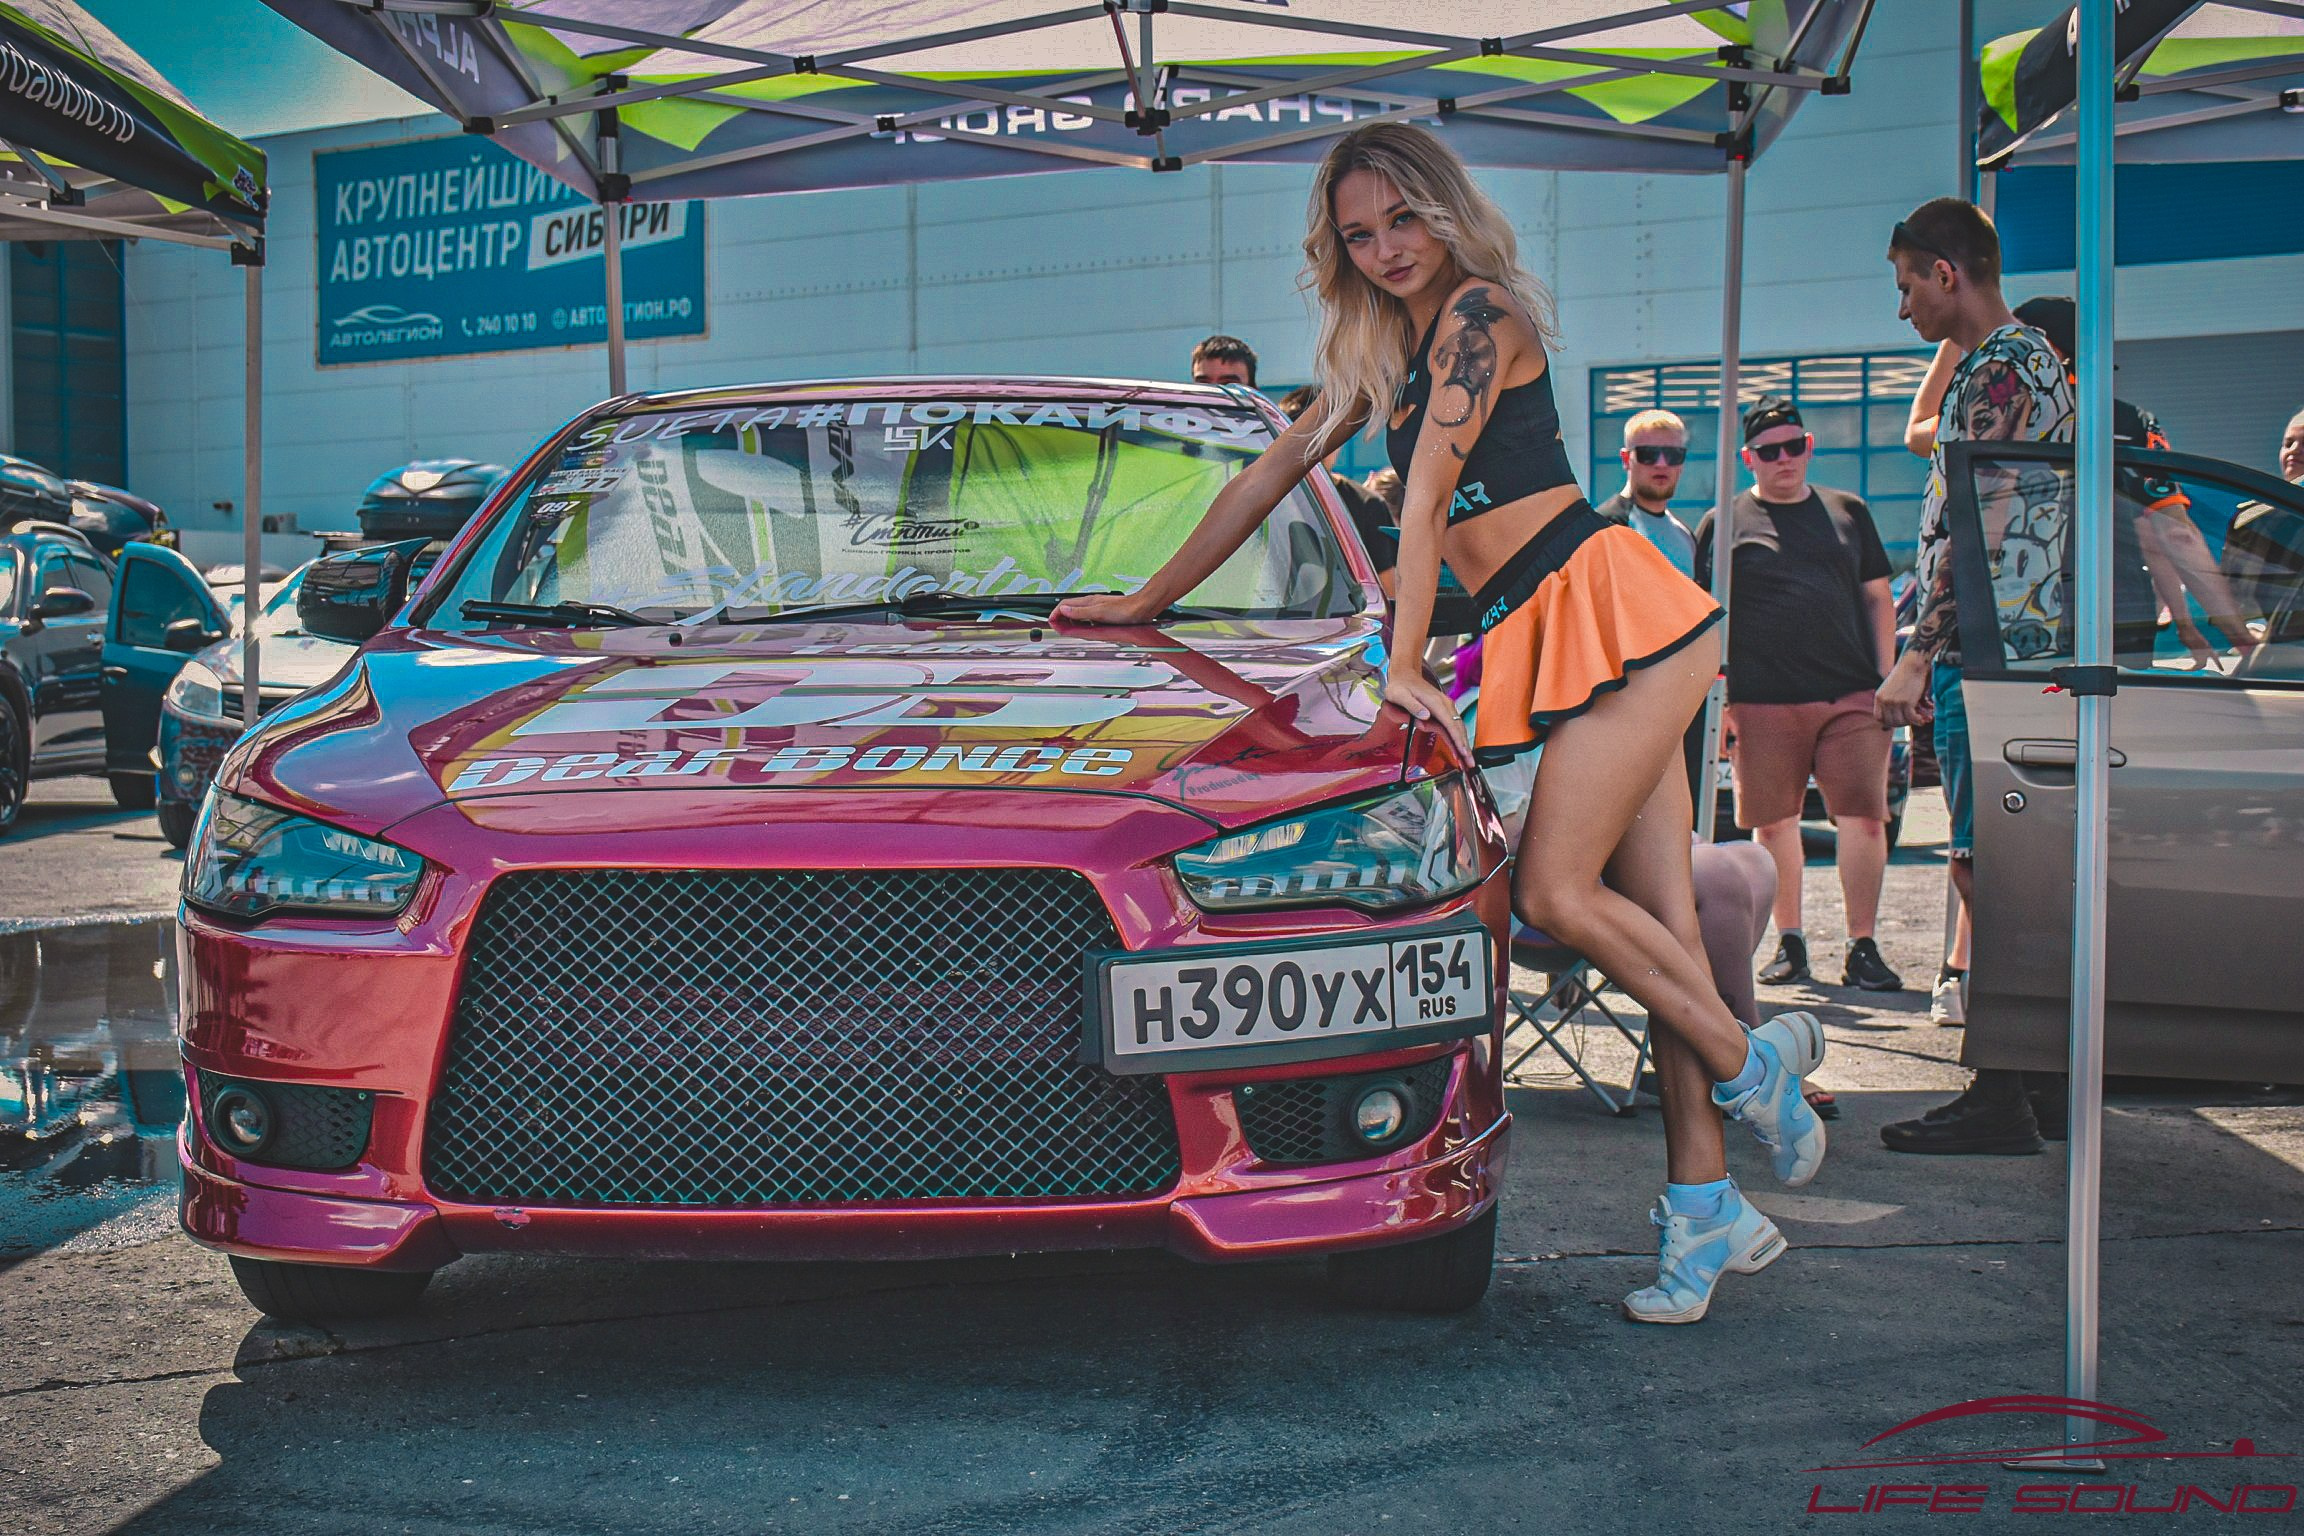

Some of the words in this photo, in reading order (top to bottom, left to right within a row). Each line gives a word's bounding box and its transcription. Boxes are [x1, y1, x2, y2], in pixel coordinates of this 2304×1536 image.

[330, 220, 523, 283] АВТОЦЕНТР
[476, 313, 502, 336] 240
[504, 313, 520, 334] 10
[521, 312, 537, 332] 10
[569, 295, 692, 328] АВТОГИОН.РФ
[330, 324, 443, 347] АВТОЛЕГИОН
[566, 406, 792, 451] SUETA
[796, 402, 1271, 438] #ПОКАЙФУ
[536, 500, 581, 514] 097
[1133, 960, 1387, 1045] Н390УХ
[1395, 938, 1471, 998] 154
[1419, 995, 1456, 1019] RUS
